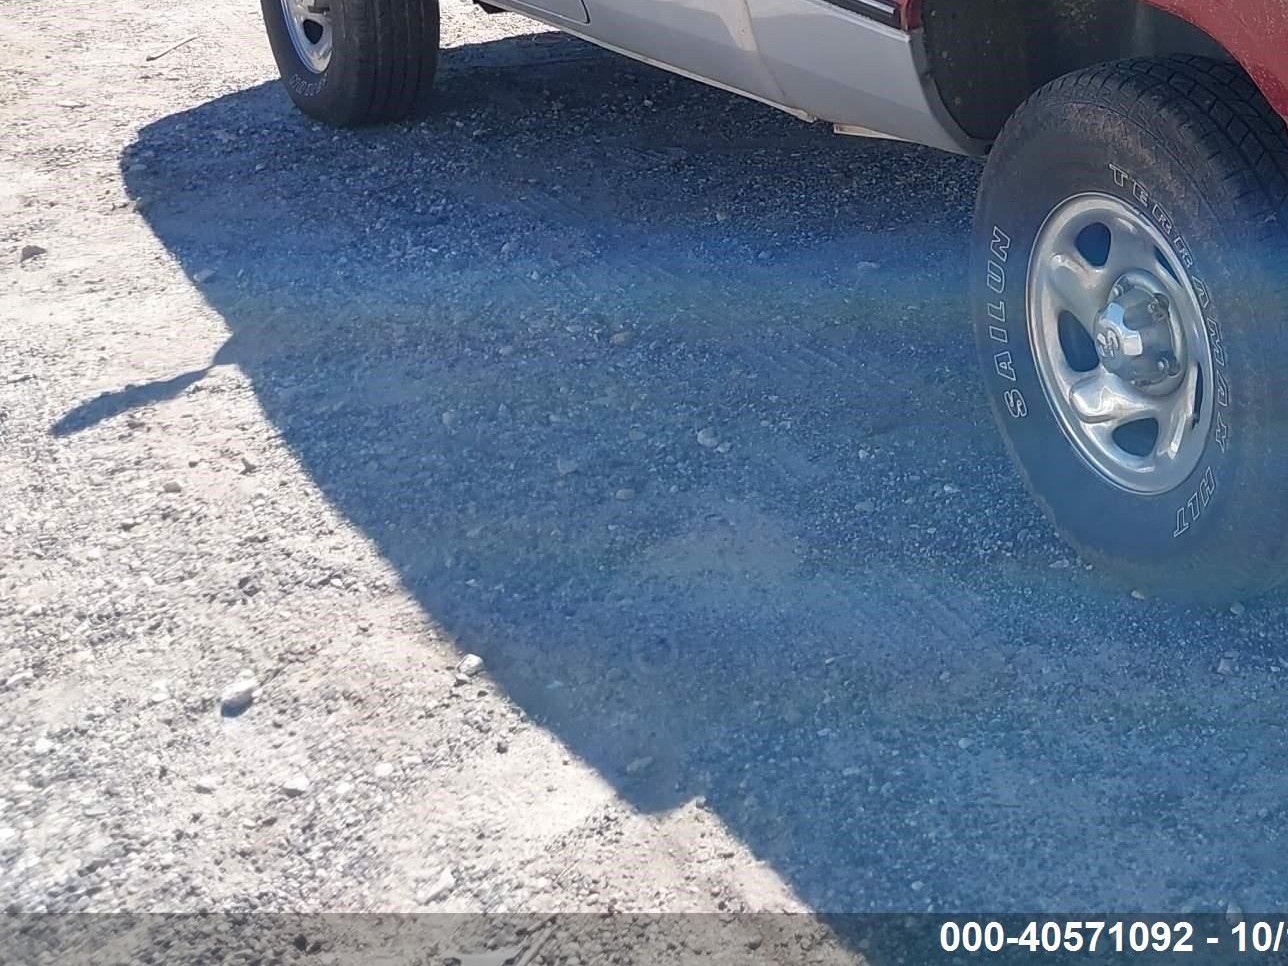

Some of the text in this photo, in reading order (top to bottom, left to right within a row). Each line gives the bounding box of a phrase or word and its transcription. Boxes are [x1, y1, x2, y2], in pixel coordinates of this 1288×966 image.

[988, 225, 1028, 420] SAILUN
[1108, 161, 1231, 539] TERRAMAX HLT
